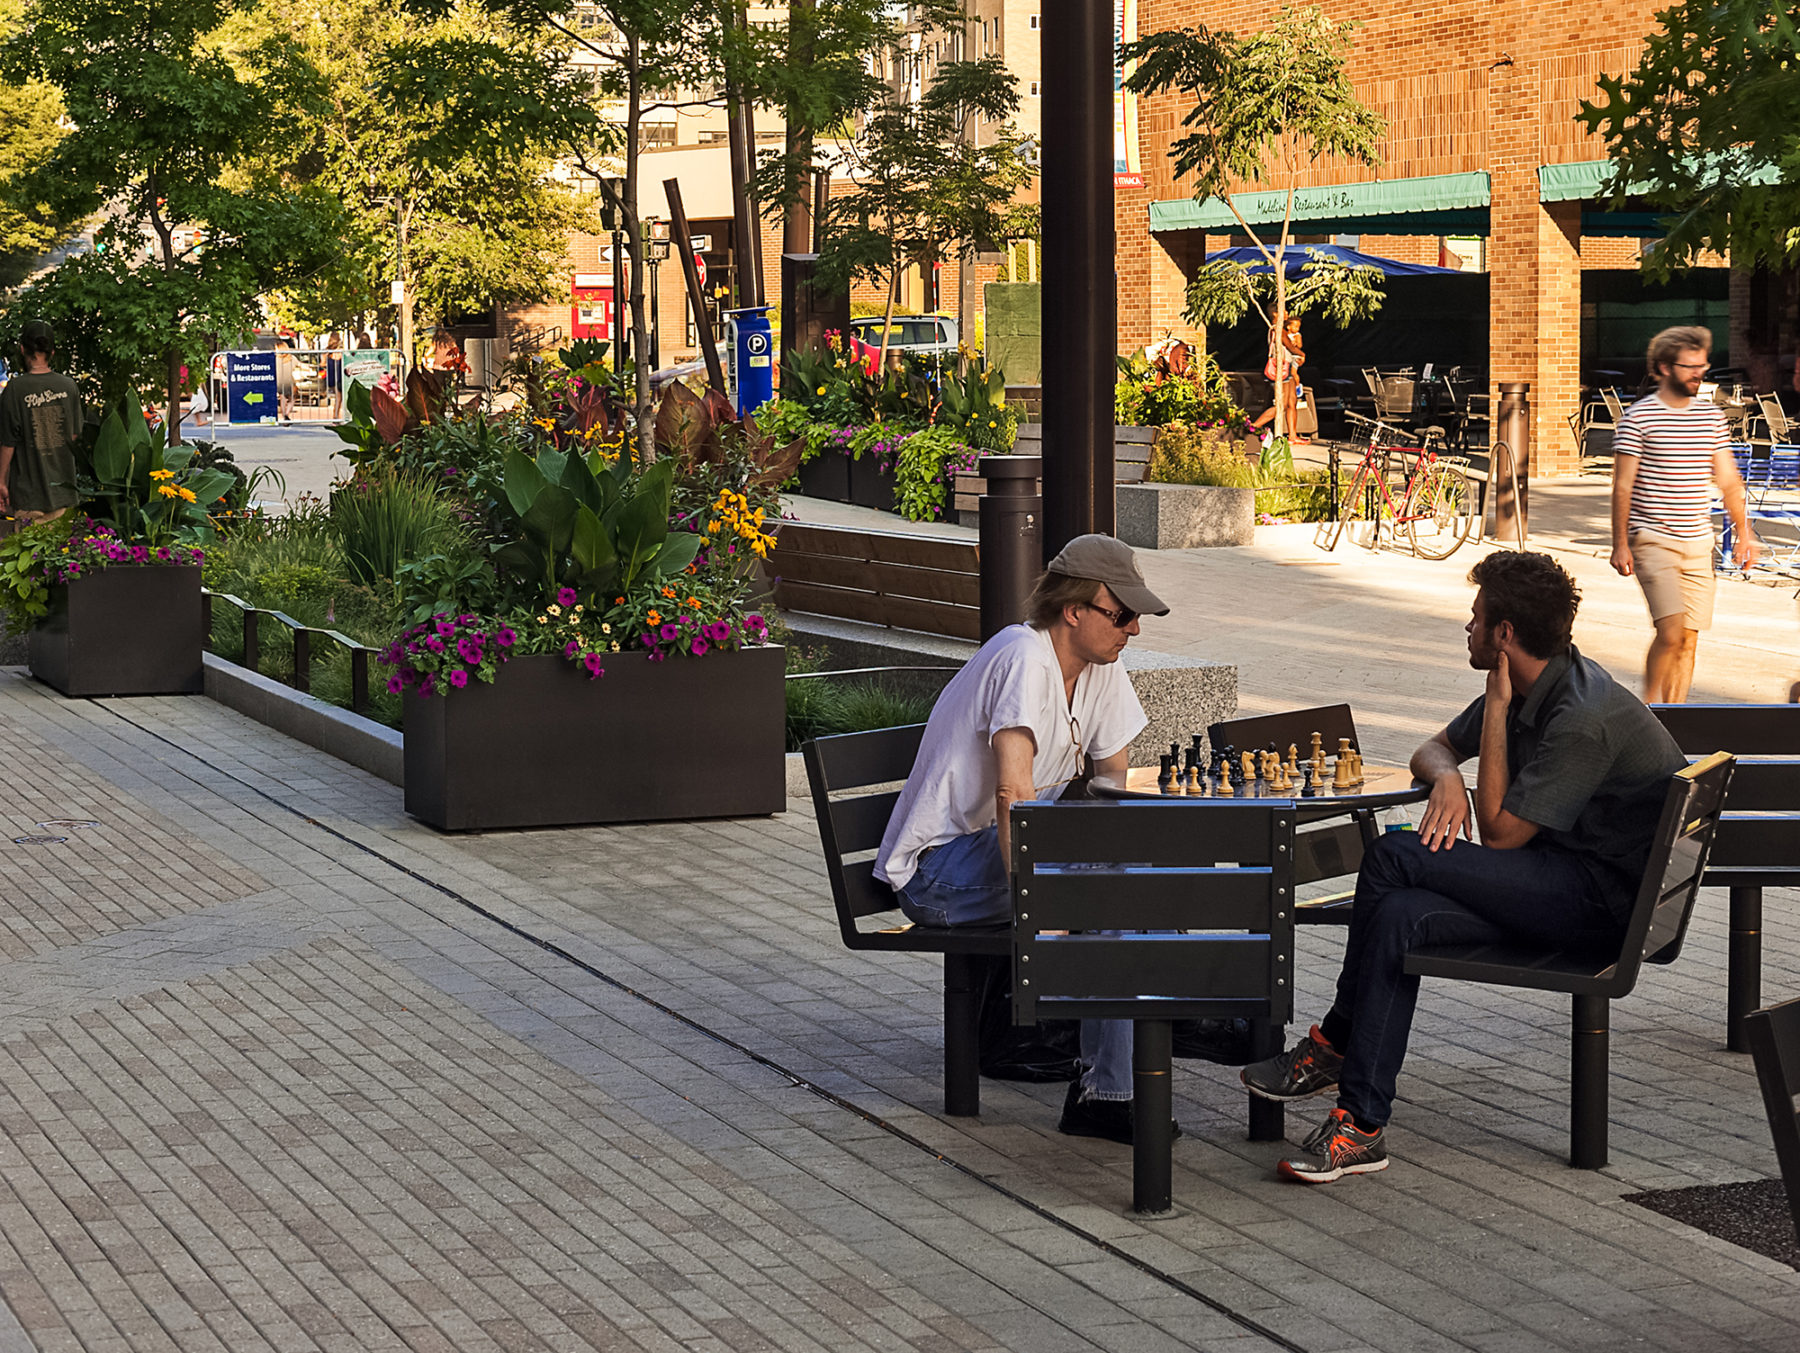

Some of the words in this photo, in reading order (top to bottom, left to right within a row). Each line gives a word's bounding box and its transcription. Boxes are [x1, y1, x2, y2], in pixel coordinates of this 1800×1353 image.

[1118, 177, 1142, 185] ITHACA
[1340, 192, 1354, 209] Bar
[752, 337, 763, 351] P
[233, 363, 250, 371] More
[250, 363, 271, 371] Stores
[230, 374, 236, 382] &
[236, 374, 275, 382] Restaurants
